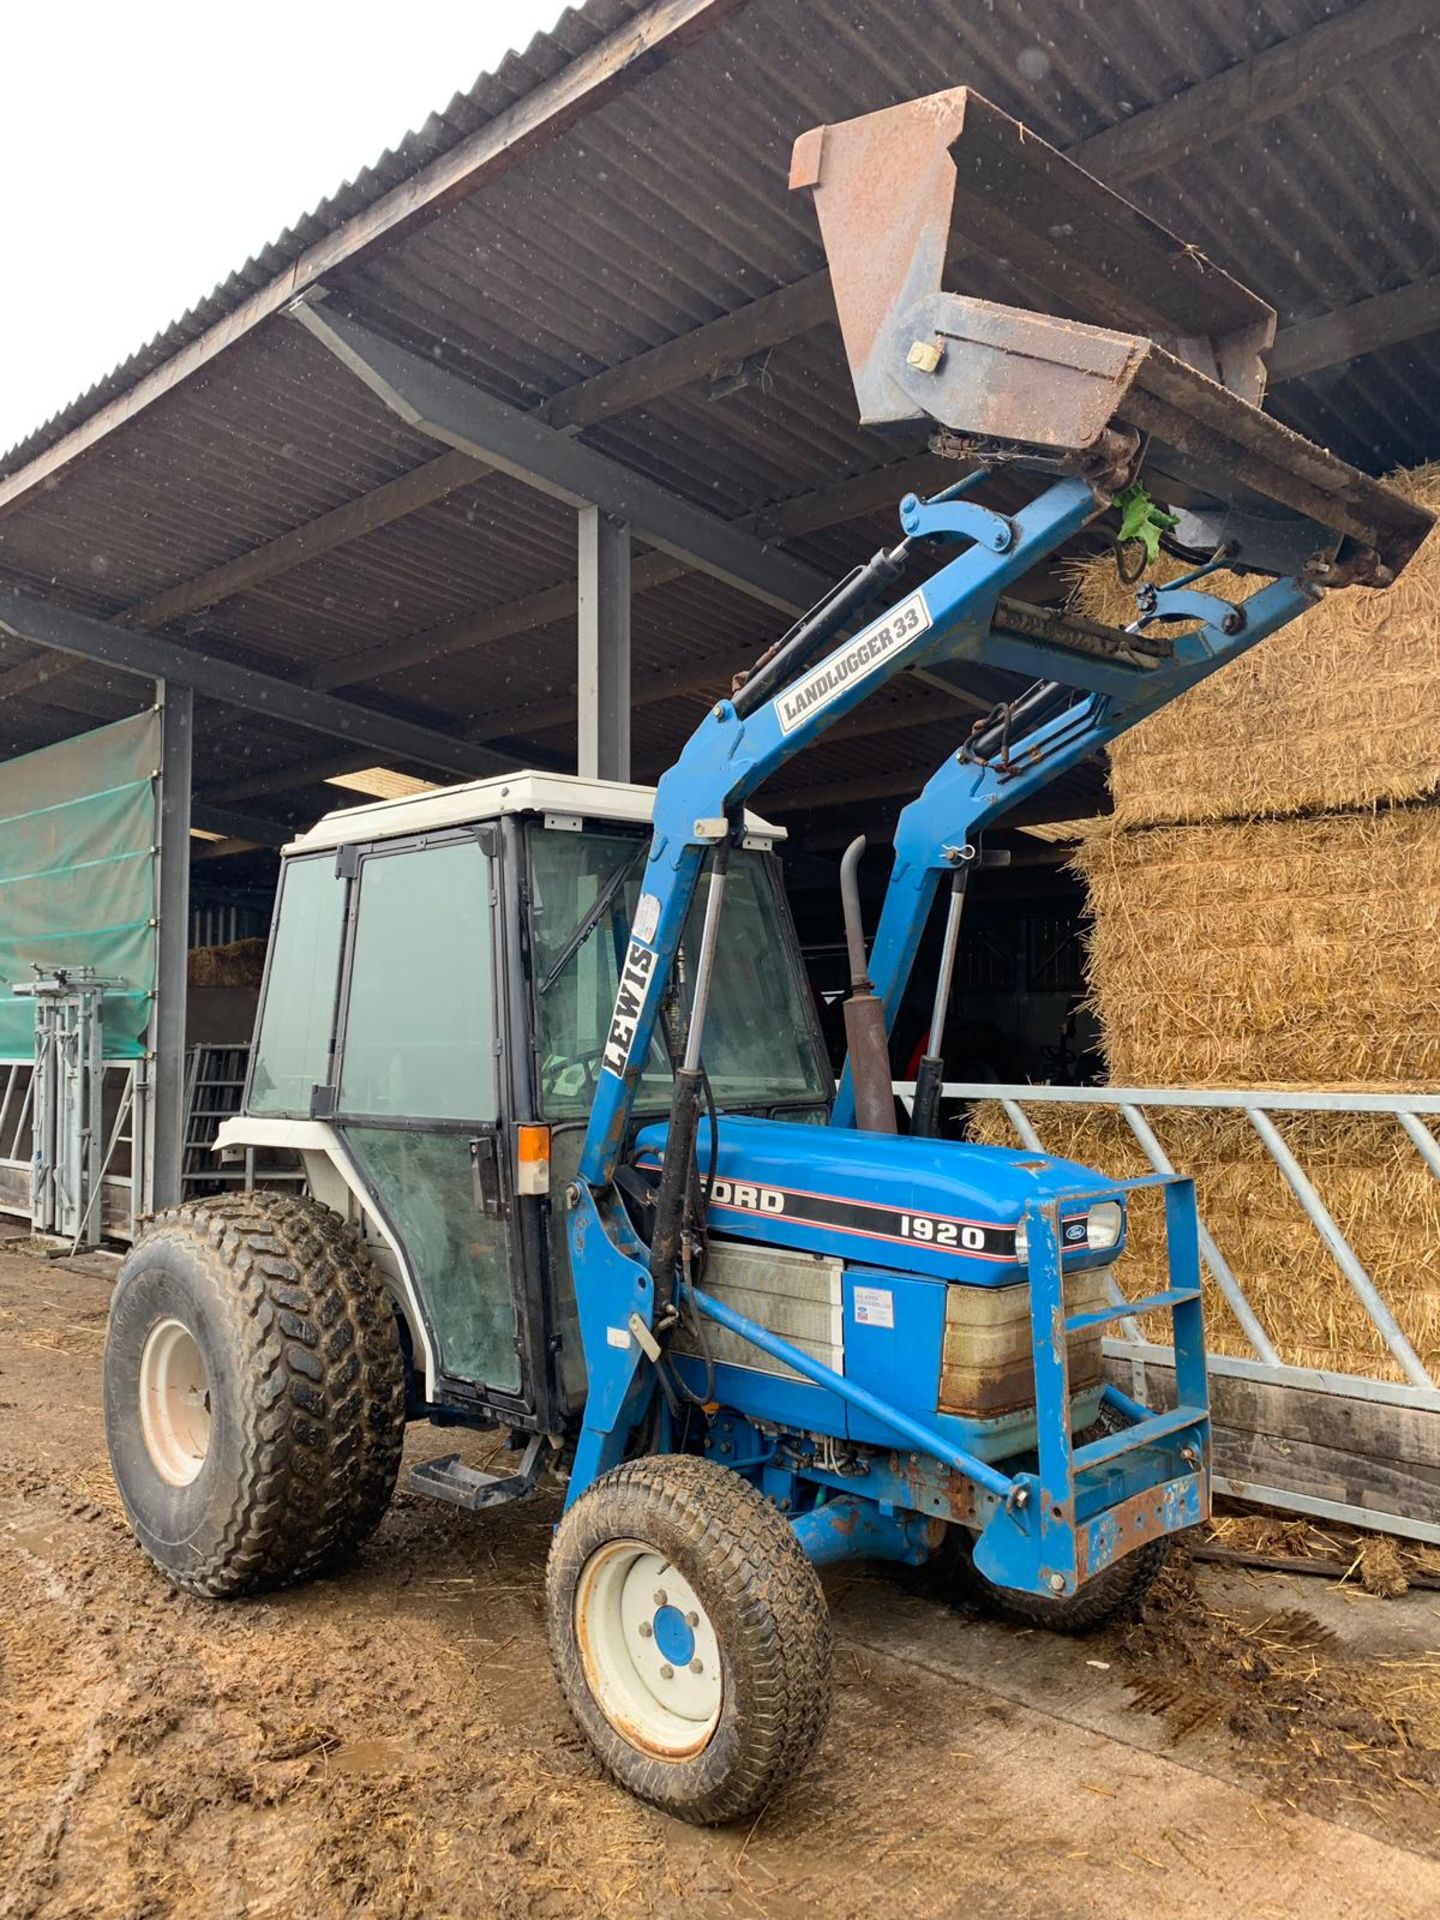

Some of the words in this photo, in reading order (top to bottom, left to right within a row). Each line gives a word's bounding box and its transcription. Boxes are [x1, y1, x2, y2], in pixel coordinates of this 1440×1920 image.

[784, 628, 895, 721] LANDLUGGER
[893, 608, 919, 638] 33
[605, 944, 653, 1078] LEWIS
[901, 1215, 985, 1250] 1920
